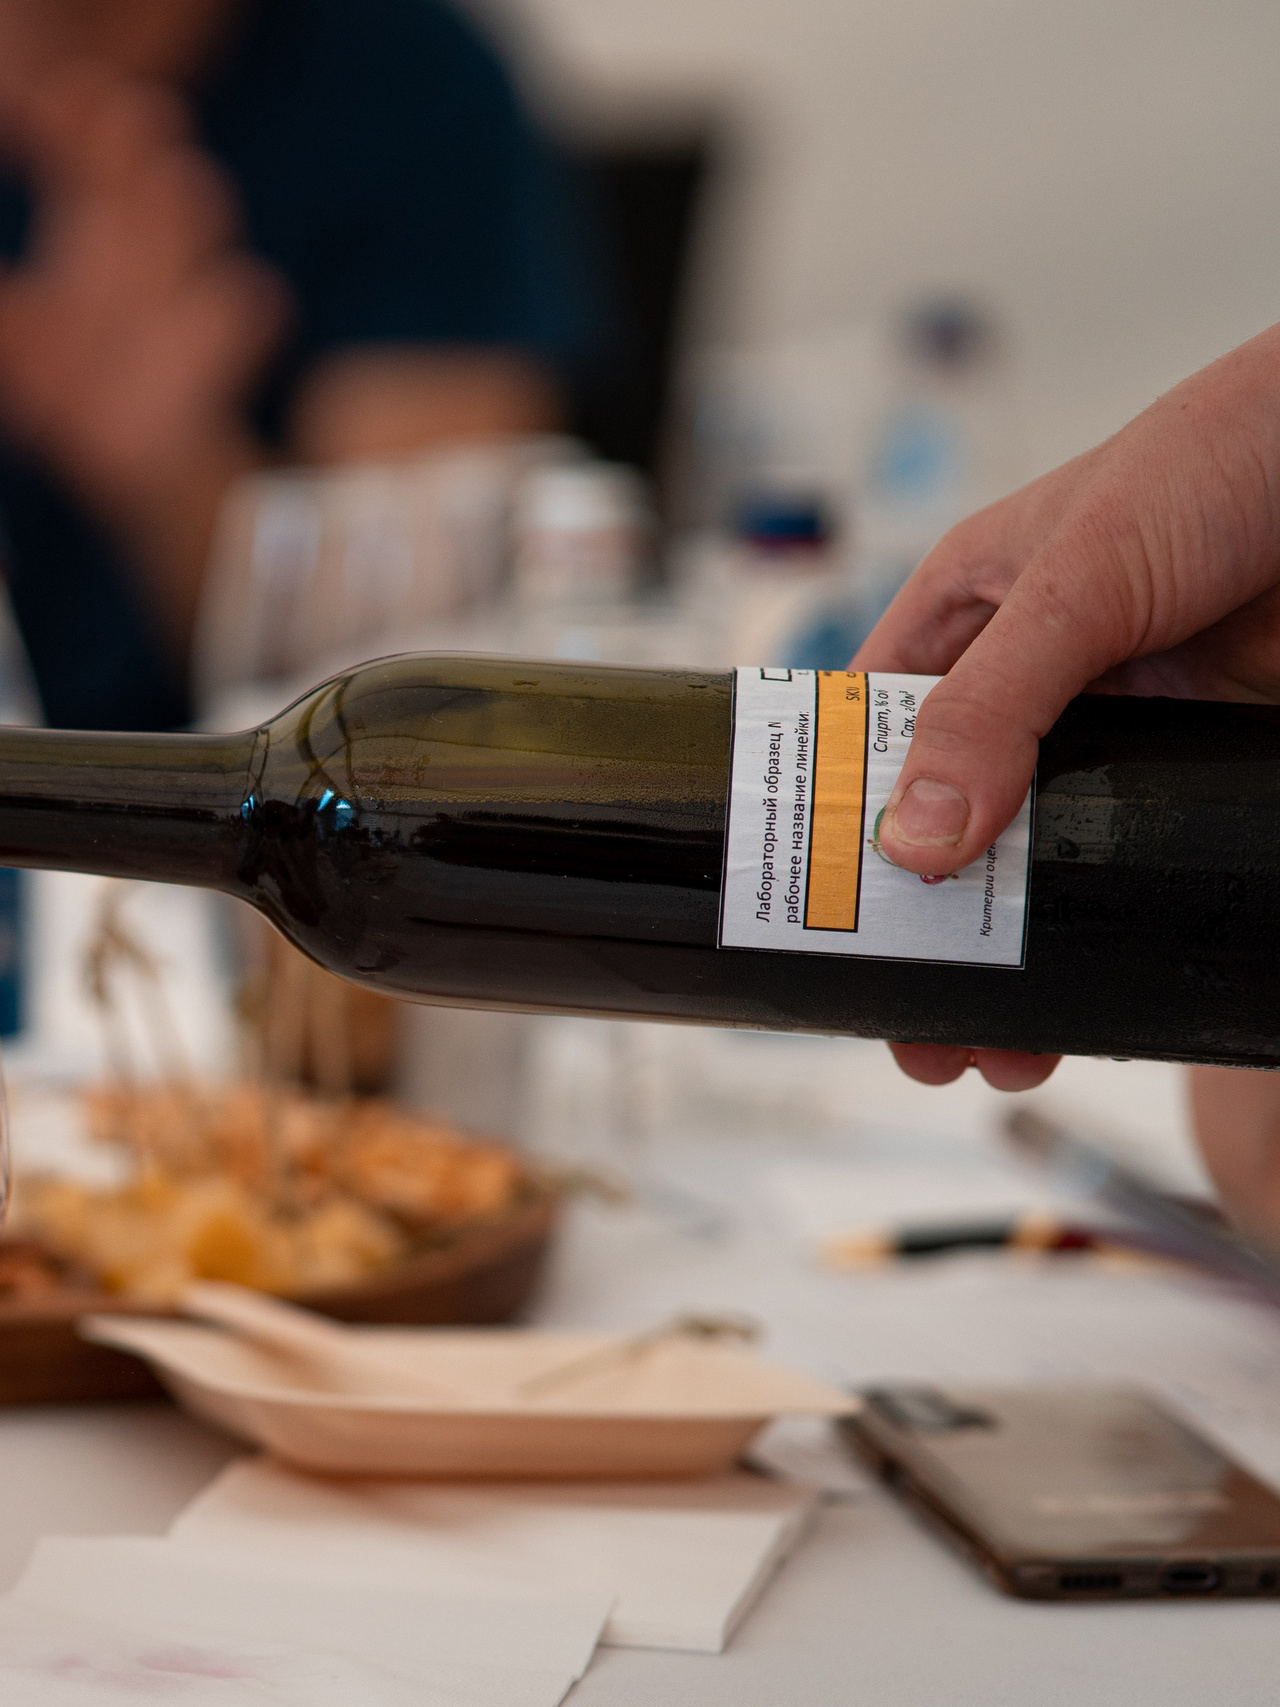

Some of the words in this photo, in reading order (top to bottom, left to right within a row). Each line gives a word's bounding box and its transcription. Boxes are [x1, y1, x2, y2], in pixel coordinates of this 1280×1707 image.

[764, 733, 784, 793] образец
[756, 798, 778, 923] Лабораторный
[783, 856, 801, 924] рабочее
[792, 776, 805, 850] название
[986, 842, 998, 872] оцен
[980, 875, 995, 936] Критерии
